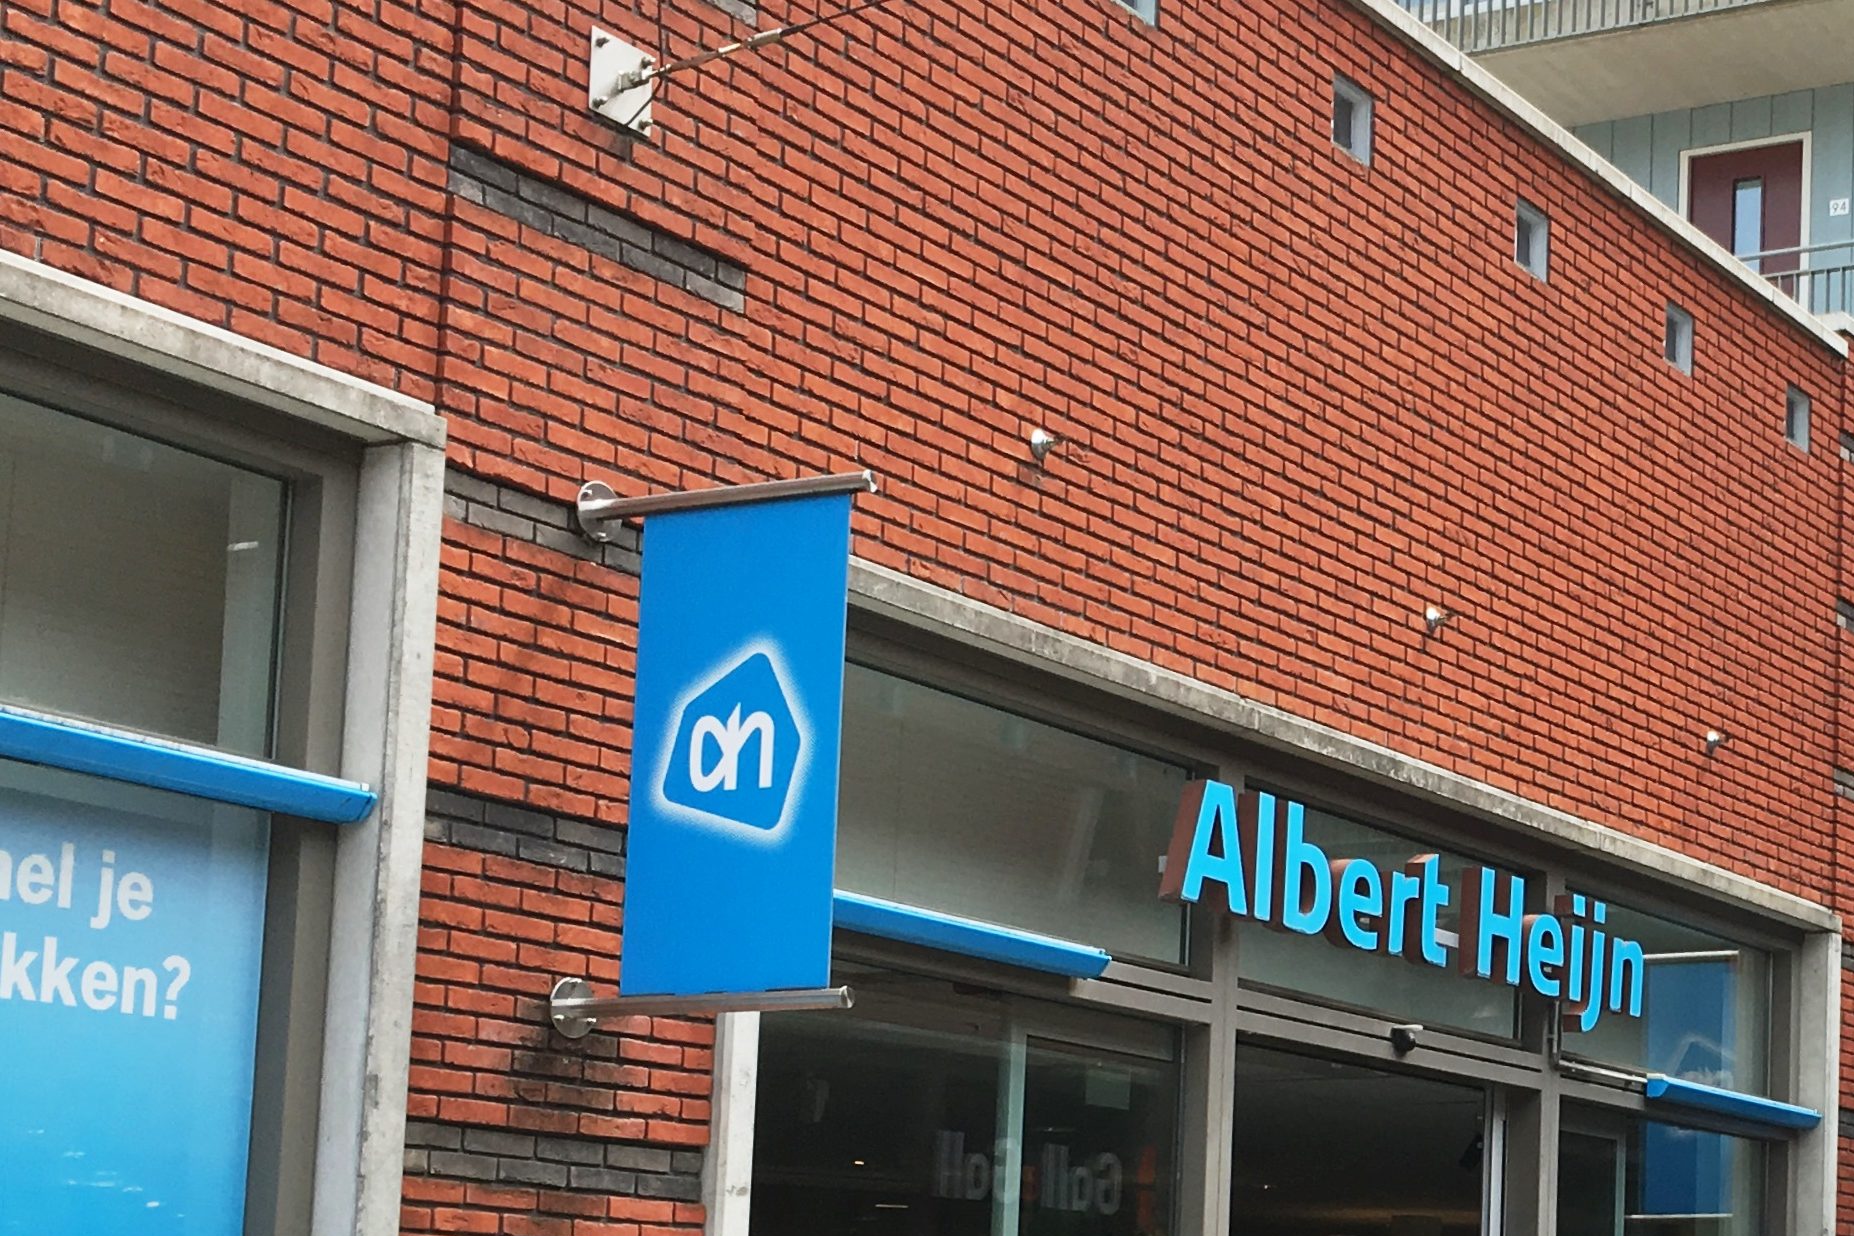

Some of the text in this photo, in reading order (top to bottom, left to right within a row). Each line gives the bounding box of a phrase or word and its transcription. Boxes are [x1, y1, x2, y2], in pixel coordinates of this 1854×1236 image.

[1832, 201, 1847, 214] 94
[90, 849, 154, 930] je
[1180, 778, 1645, 1033] Albert Heijn
[0, 931, 192, 1021] kken?
